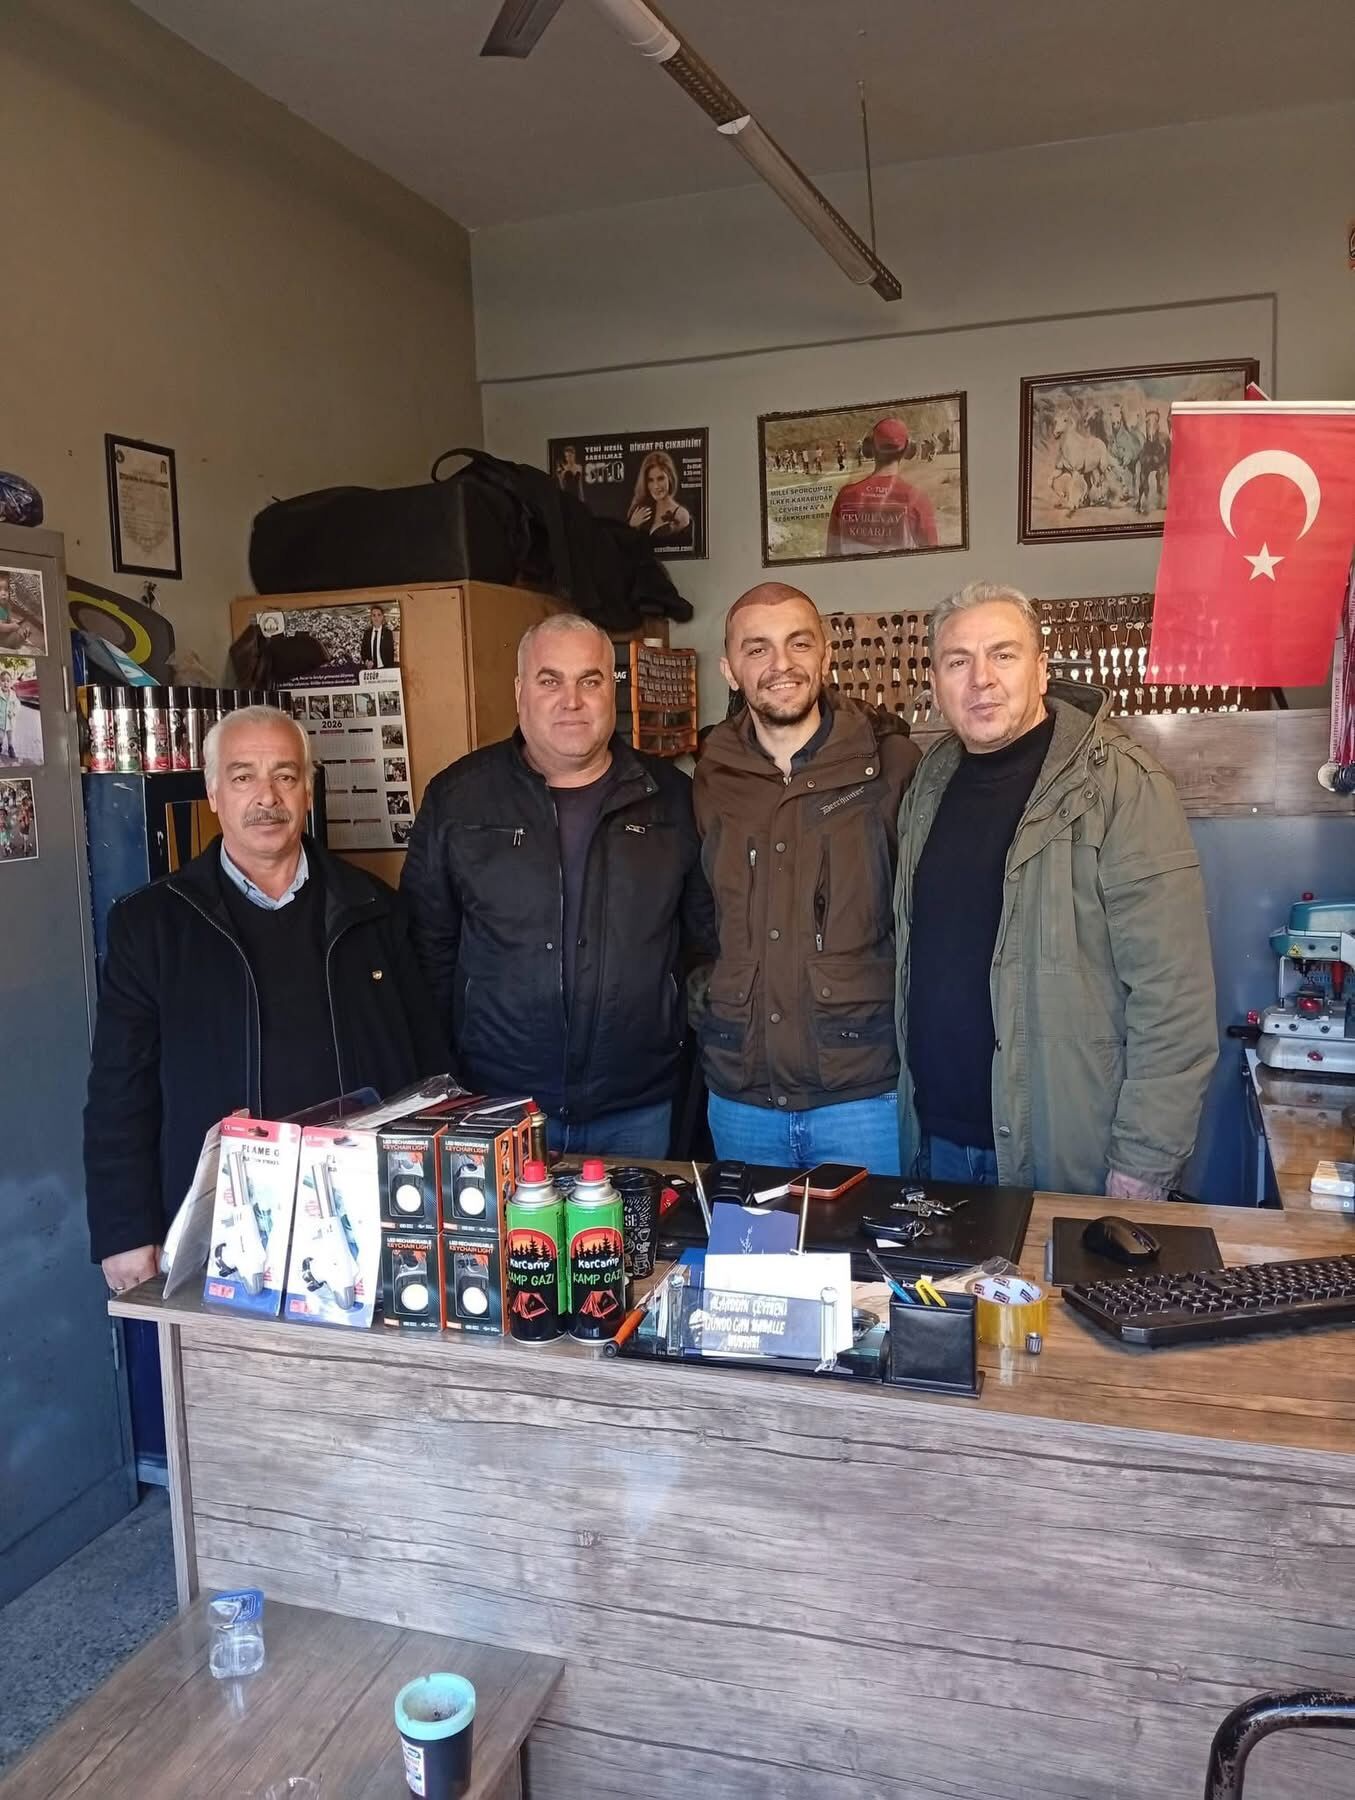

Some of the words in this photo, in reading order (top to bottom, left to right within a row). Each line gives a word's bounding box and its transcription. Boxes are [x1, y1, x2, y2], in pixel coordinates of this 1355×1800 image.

[321, 720, 343, 729] 2026
[241, 1144, 271, 1157] FLAME
[578, 1257, 619, 1269] KarCamp
[573, 1272, 600, 1285] KAMP
